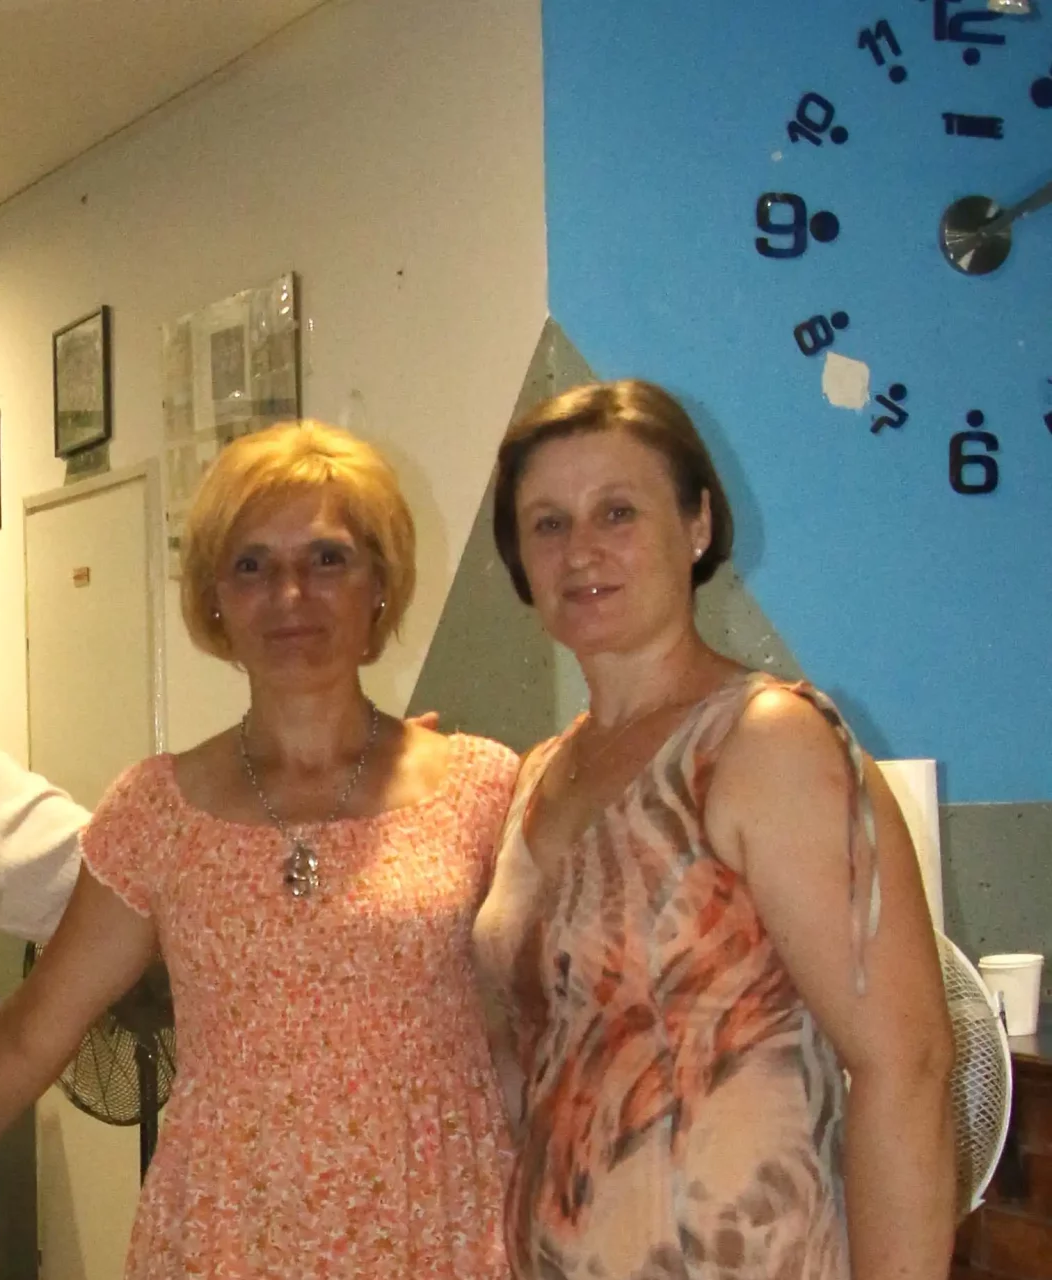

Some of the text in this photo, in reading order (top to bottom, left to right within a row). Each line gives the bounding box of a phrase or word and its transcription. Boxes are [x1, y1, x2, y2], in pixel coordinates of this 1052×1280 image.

[858, 19, 902, 66] 11
[787, 92, 835, 146] 10
[756, 192, 807, 258] 9
[793, 314, 834, 357] 8
[949, 431, 999, 495] 6
